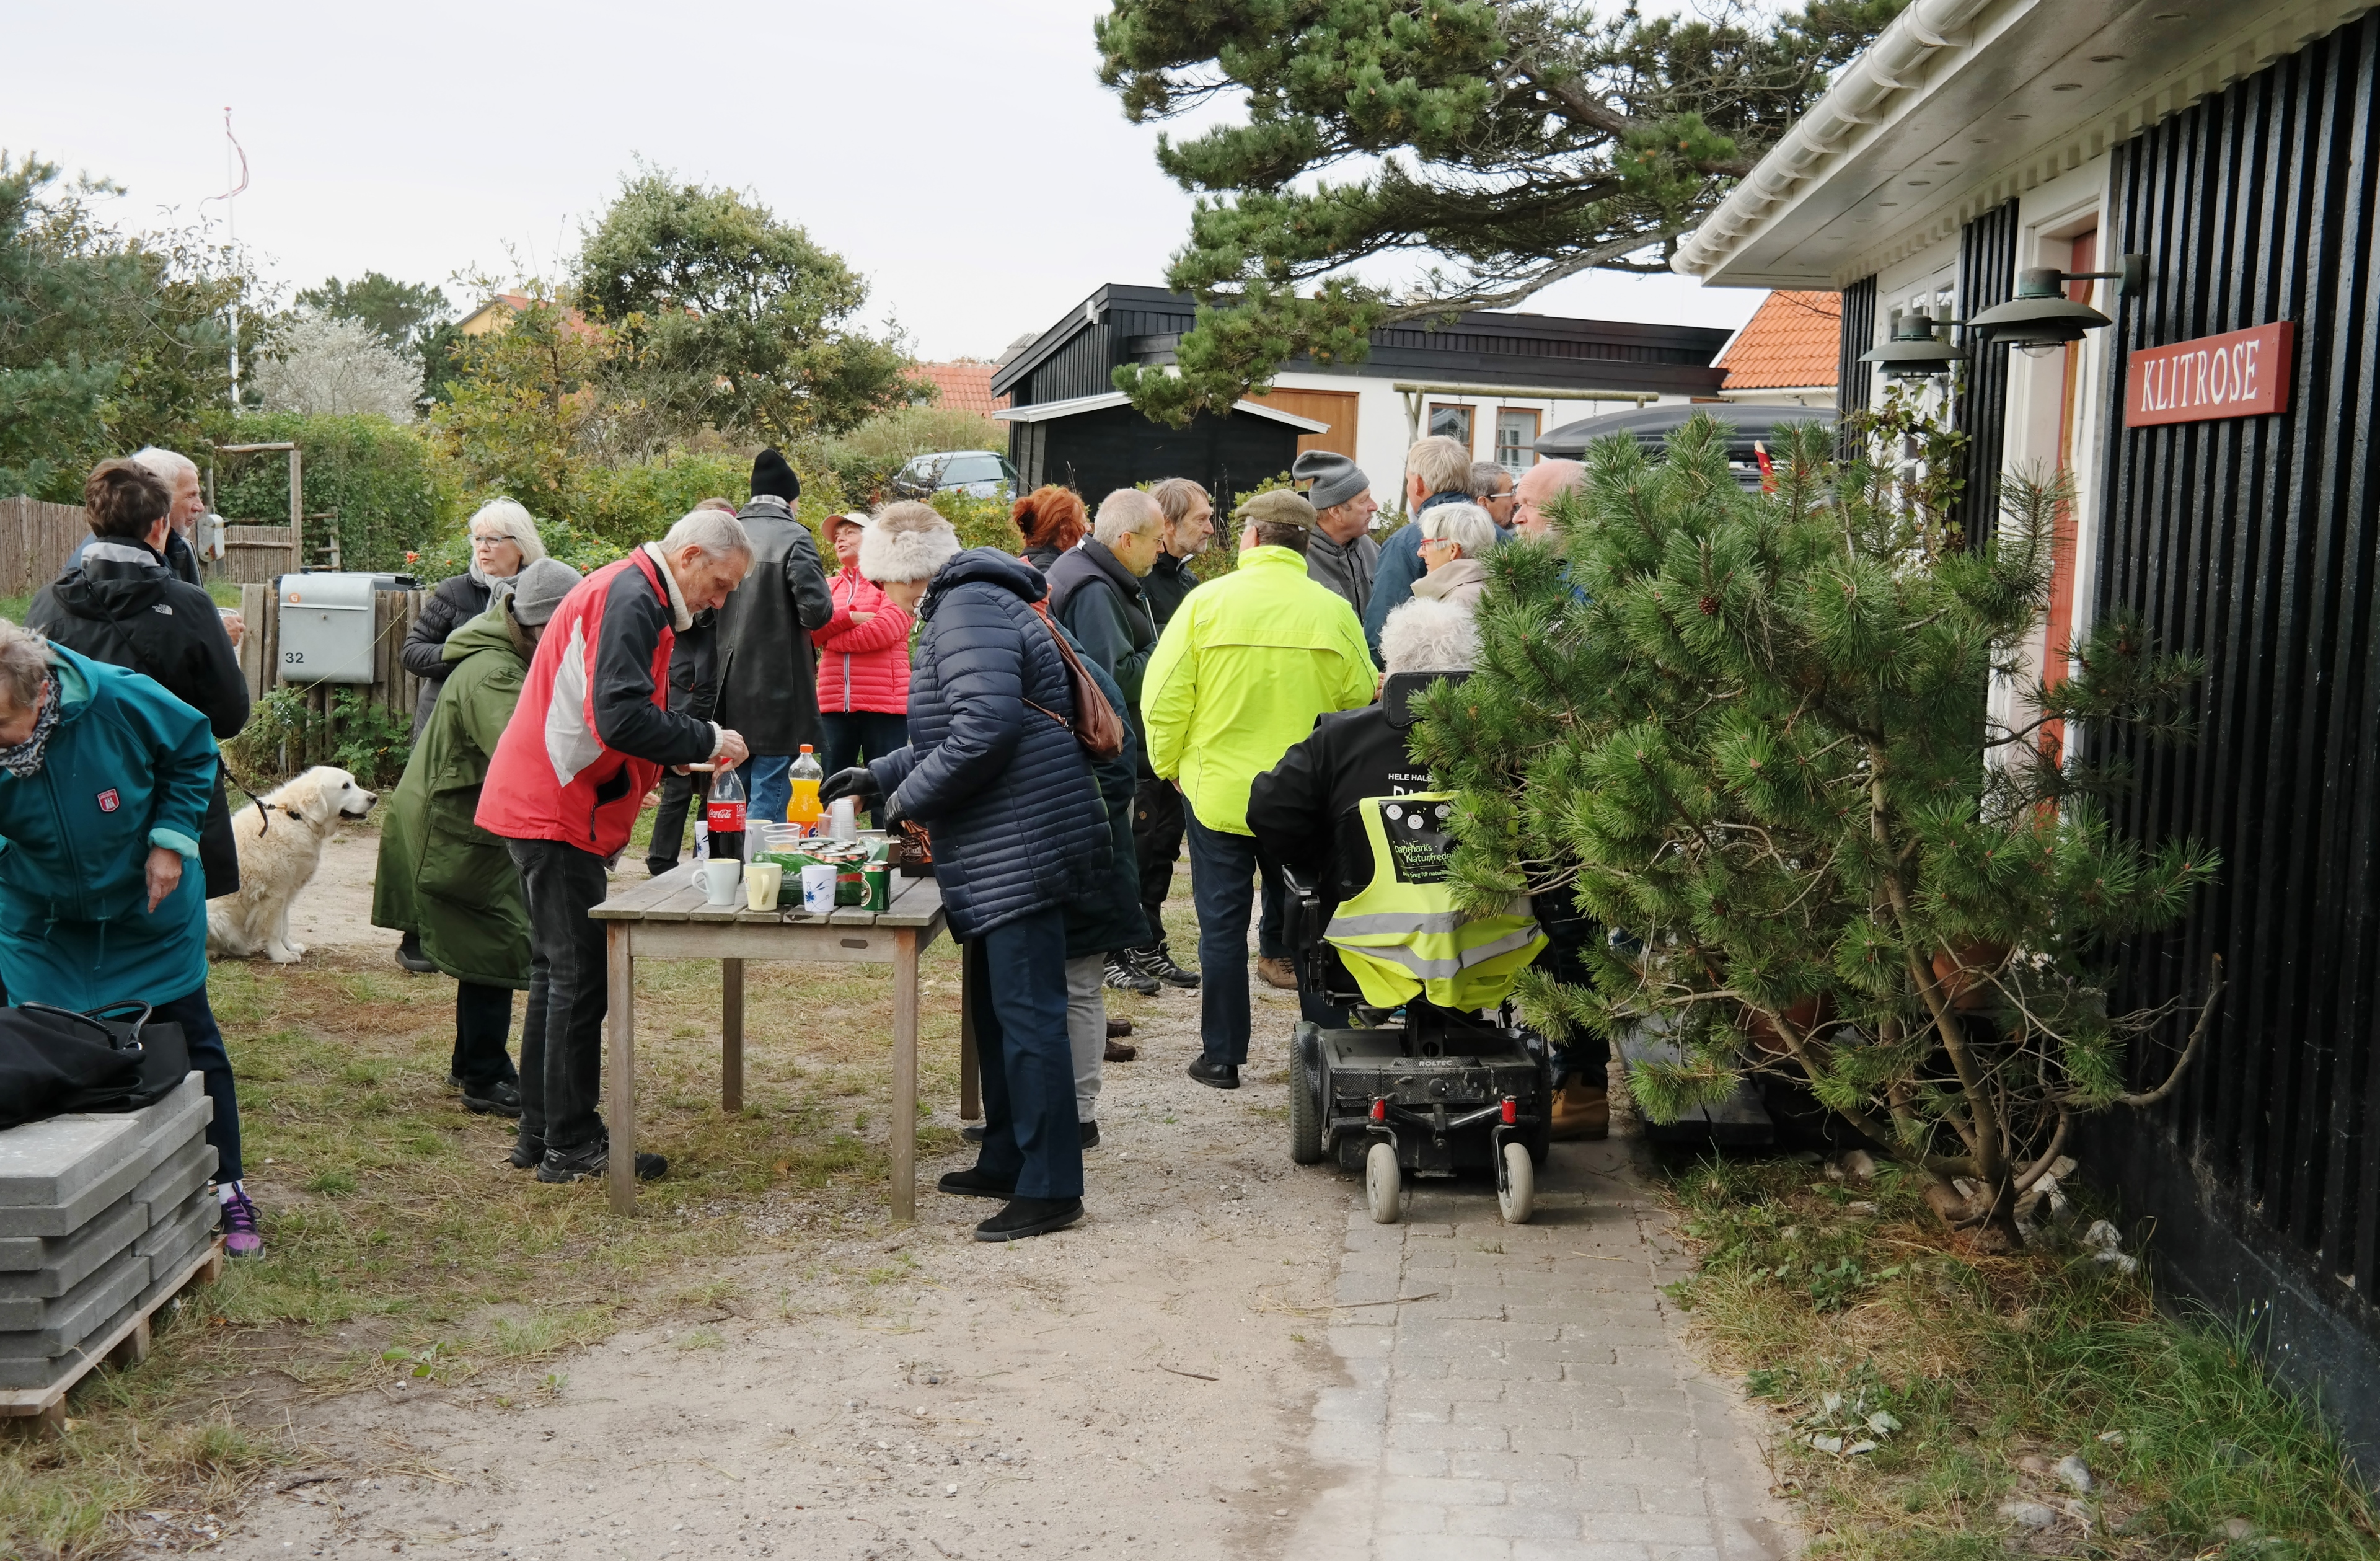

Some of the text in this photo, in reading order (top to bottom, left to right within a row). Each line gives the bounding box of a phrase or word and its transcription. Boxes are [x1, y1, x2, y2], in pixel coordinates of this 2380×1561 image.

[2140, 338, 2260, 412] KLITROSE
[285, 652, 304, 663] 32
[708, 808, 733, 819] Coca-Cola
[1394, 844, 1432, 853] Danmarks
[1406, 852, 1455, 863] Naturfredni
